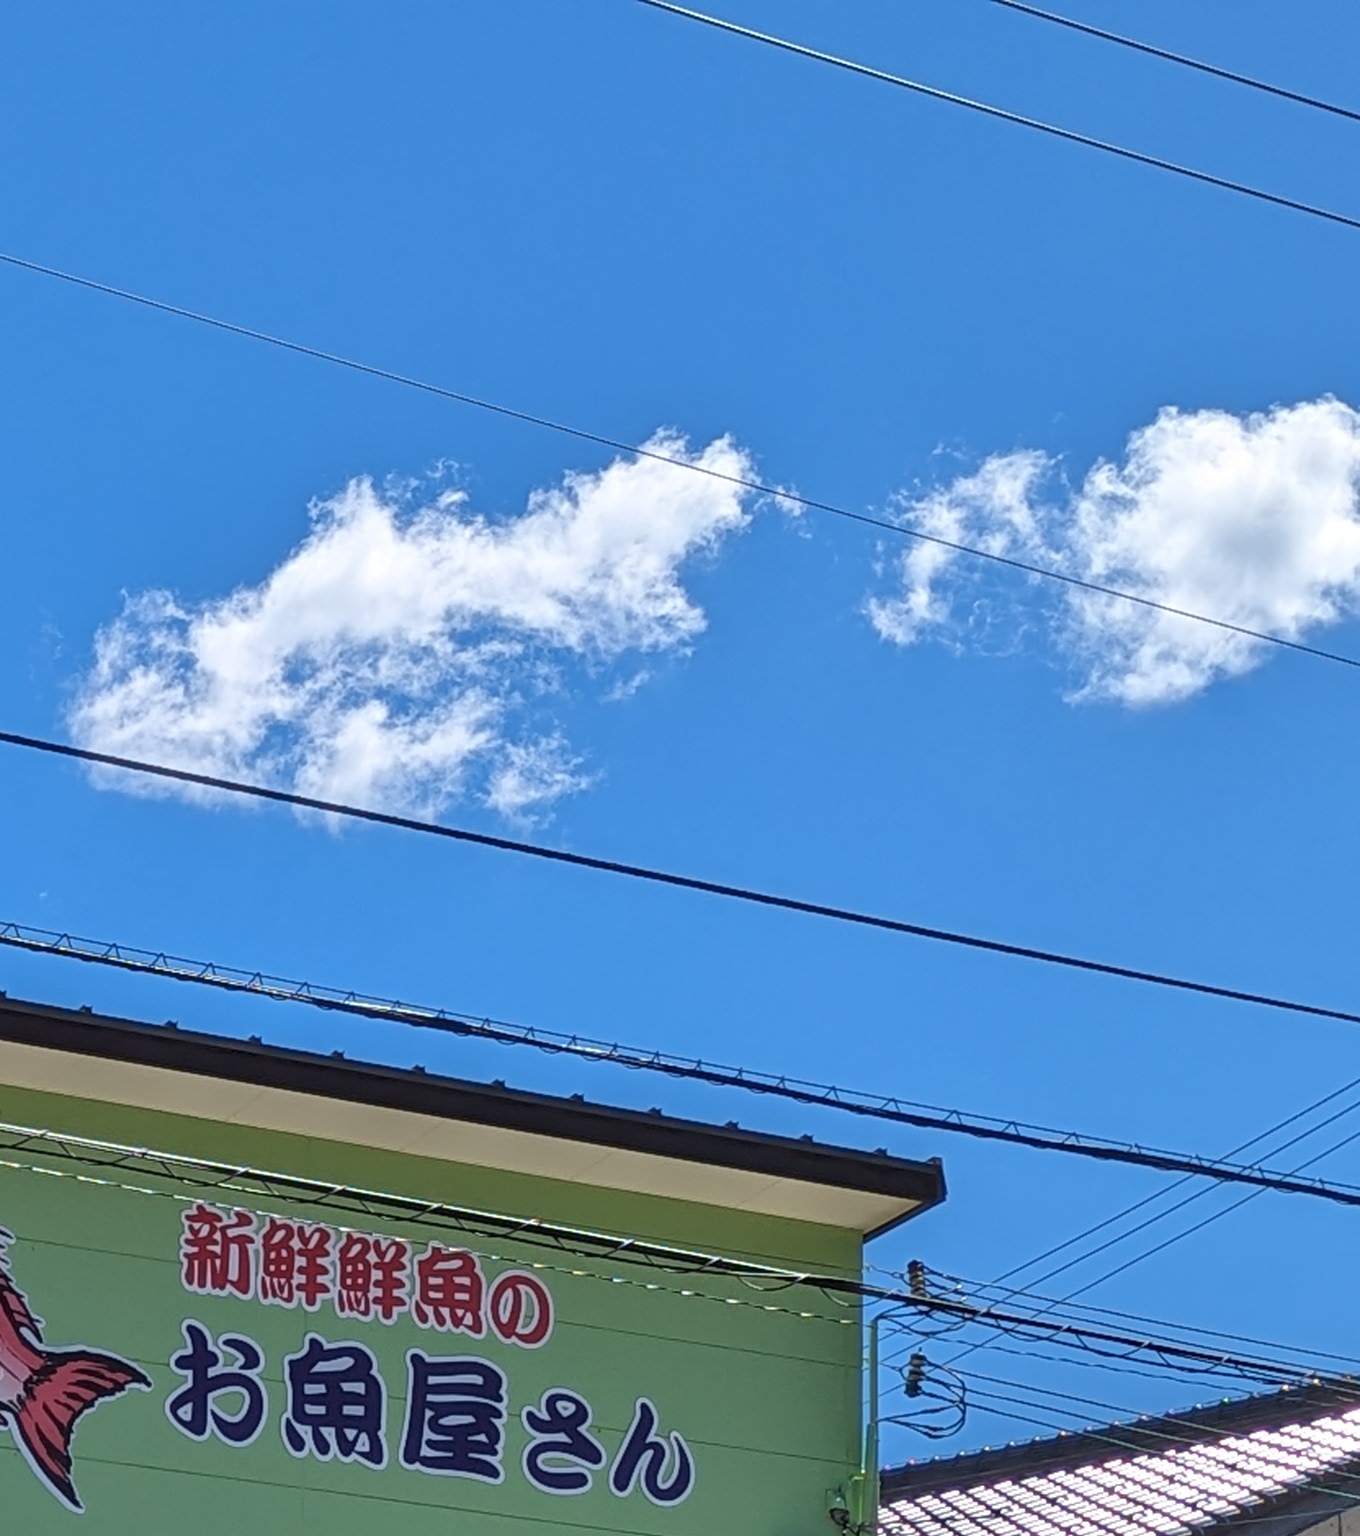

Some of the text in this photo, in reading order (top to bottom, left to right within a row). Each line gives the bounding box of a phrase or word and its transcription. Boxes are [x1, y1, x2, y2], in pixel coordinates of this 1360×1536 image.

[180, 1202, 553, 1349] 新鮮鮮魚の
[166, 1319, 696, 1506] お魚屋さん
